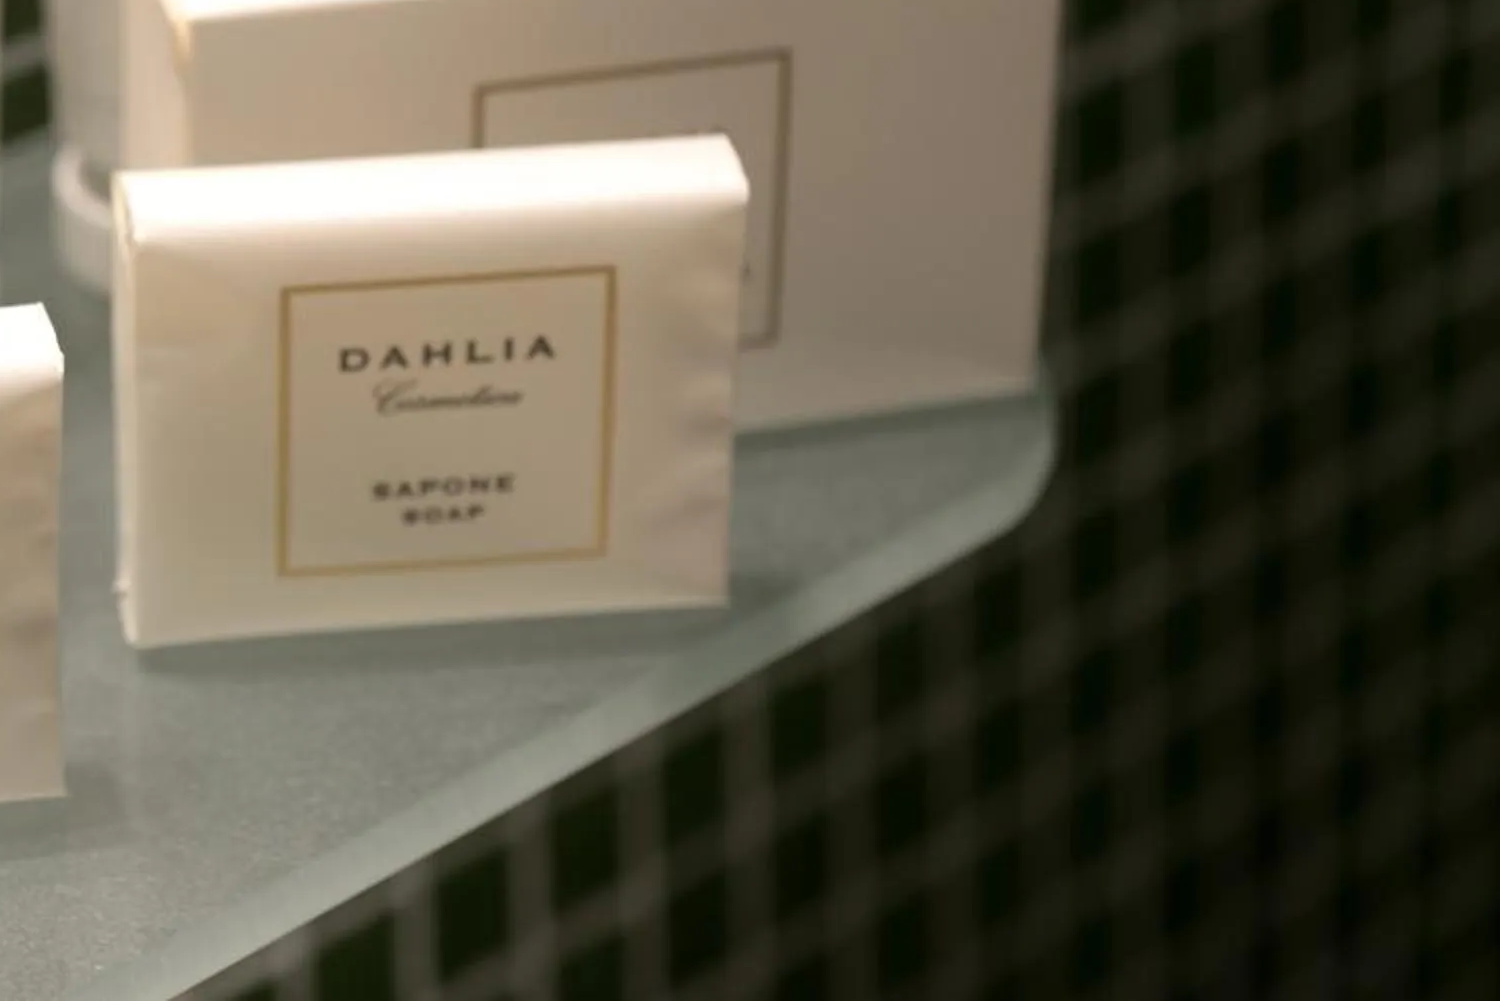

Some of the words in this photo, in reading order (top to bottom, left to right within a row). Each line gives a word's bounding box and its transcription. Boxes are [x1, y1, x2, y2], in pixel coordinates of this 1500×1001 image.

[337, 334, 555, 374] DAHLIA
[371, 472, 516, 501] SAPONE
[402, 504, 485, 526] SOAP
